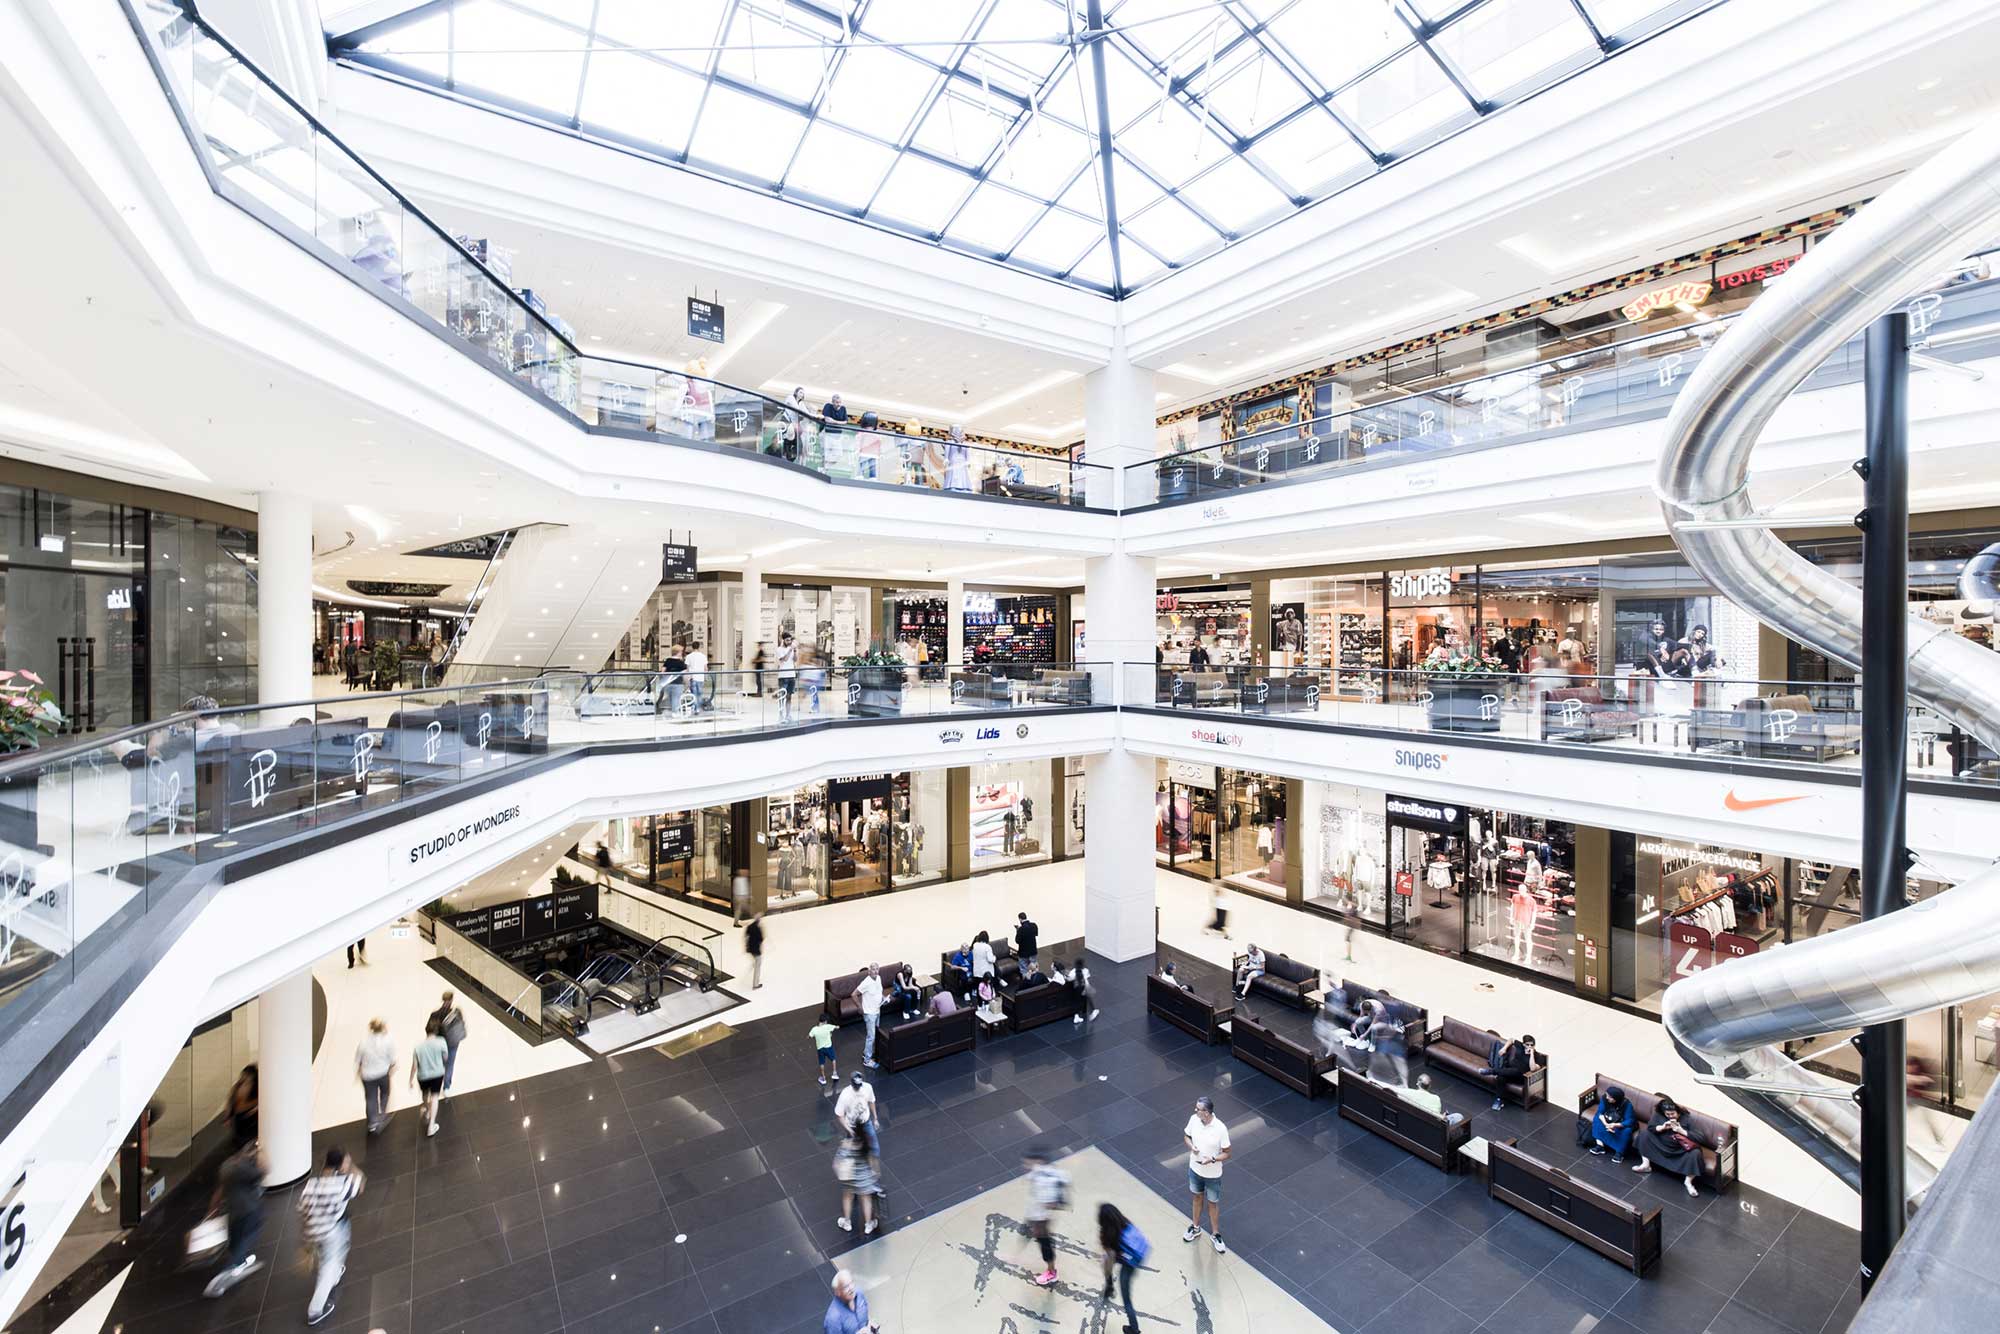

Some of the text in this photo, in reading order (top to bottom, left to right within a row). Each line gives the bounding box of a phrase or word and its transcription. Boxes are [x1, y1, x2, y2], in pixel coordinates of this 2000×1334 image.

[1715, 266, 1766, 290] TOYS
[1624, 283, 1709, 319] SMYTHS
[1391, 573, 1451, 601] snipes
[1156, 593, 1179, 611] city
[976, 727, 1000, 740] Lids
[1191, 729, 1244, 748] shoe city
[1395, 749, 1441, 771] snipes
[1386, 800, 1442, 820] strellson
[410, 805, 520, 863] STUDIO OF WONDERS
[1640, 842, 1686, 859] ARMANI
[1686, 850, 1761, 872] EXCHANGE
[456, 913, 488, 928] Kunden-WC
[460, 926, 488, 938] arderobe
[1682, 934, 1745, 955] UP TO
